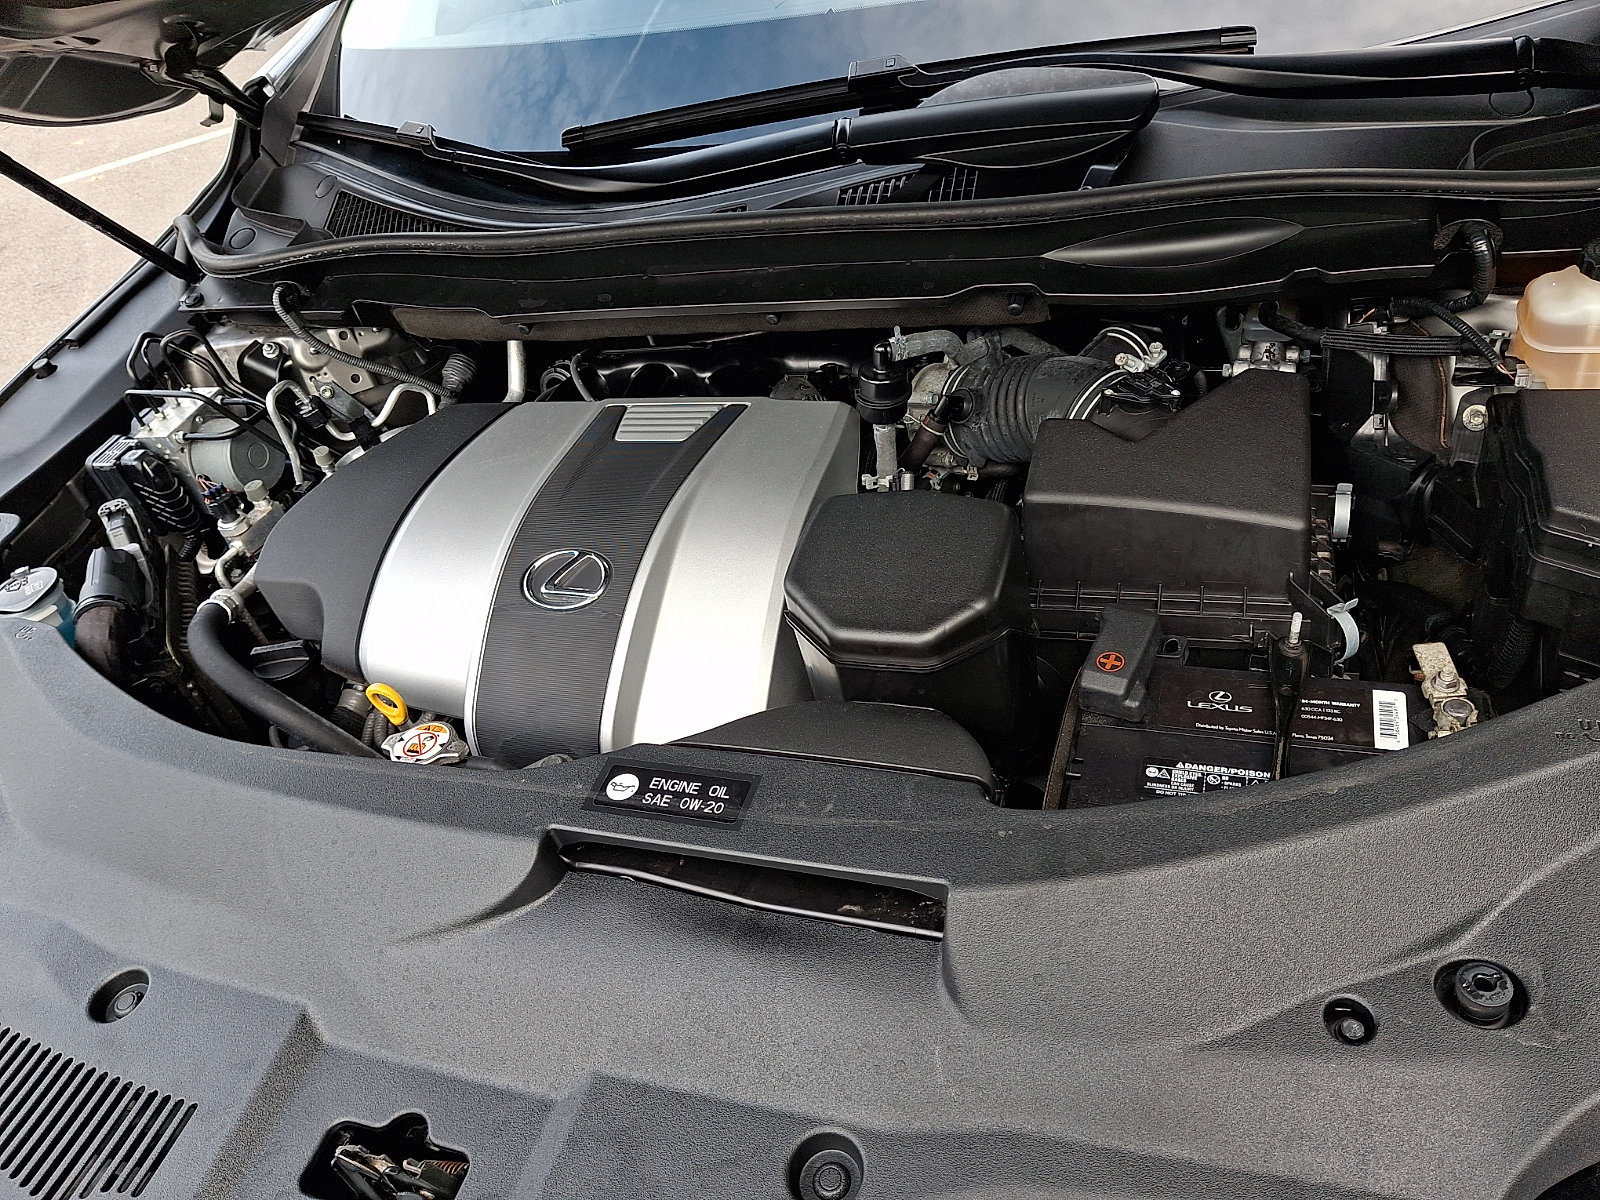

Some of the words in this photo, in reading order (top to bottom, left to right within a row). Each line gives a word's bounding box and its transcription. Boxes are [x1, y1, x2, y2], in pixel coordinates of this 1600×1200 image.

[1187, 700, 1253, 713] LEXUS
[1195, 722, 1219, 730] Distributed
[1185, 763, 1271, 778] DANGER/POISON
[649, 777, 701, 795] ENGINE
[708, 785, 730, 799] OIL
[642, 793, 673, 807] SAE
[679, 797, 724, 814] 0W-20
